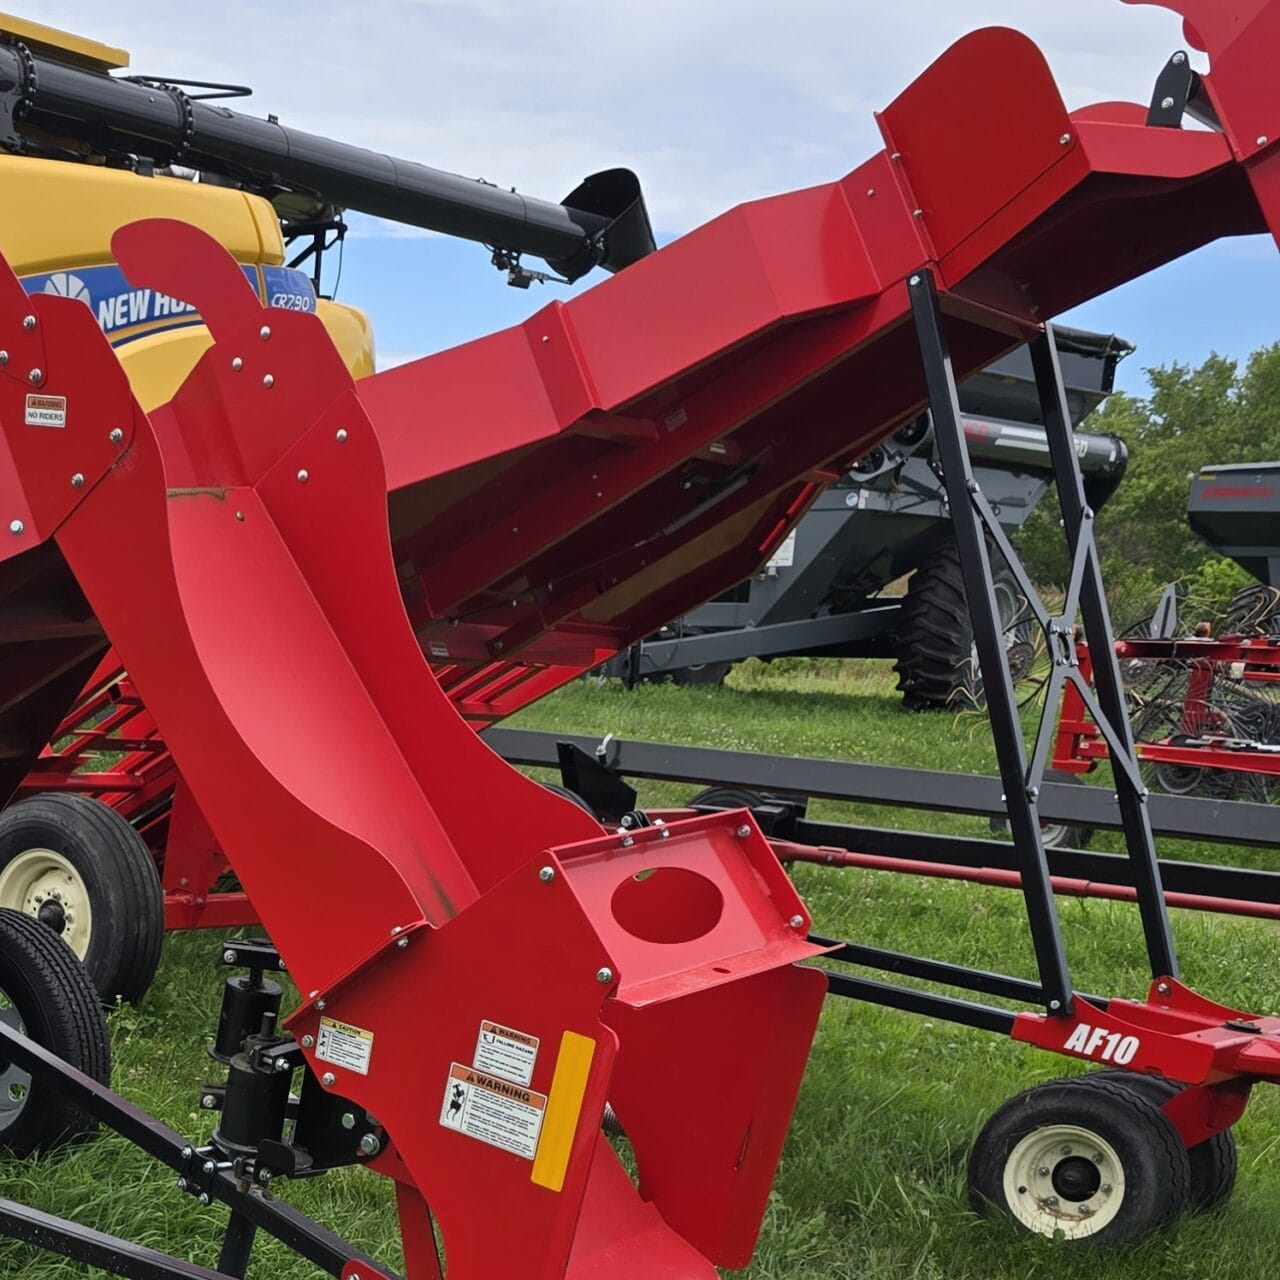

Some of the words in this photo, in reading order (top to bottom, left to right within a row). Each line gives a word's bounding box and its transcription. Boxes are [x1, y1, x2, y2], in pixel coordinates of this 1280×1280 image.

[98, 289, 151, 330] NEW
[28, 411, 38, 419] NO
[39, 412, 64, 421] RIDERS
[498, 1029, 531, 1045] WARNING
[1063, 1023, 1140, 1065] AF10
[477, 1075, 531, 1103] WARNING
